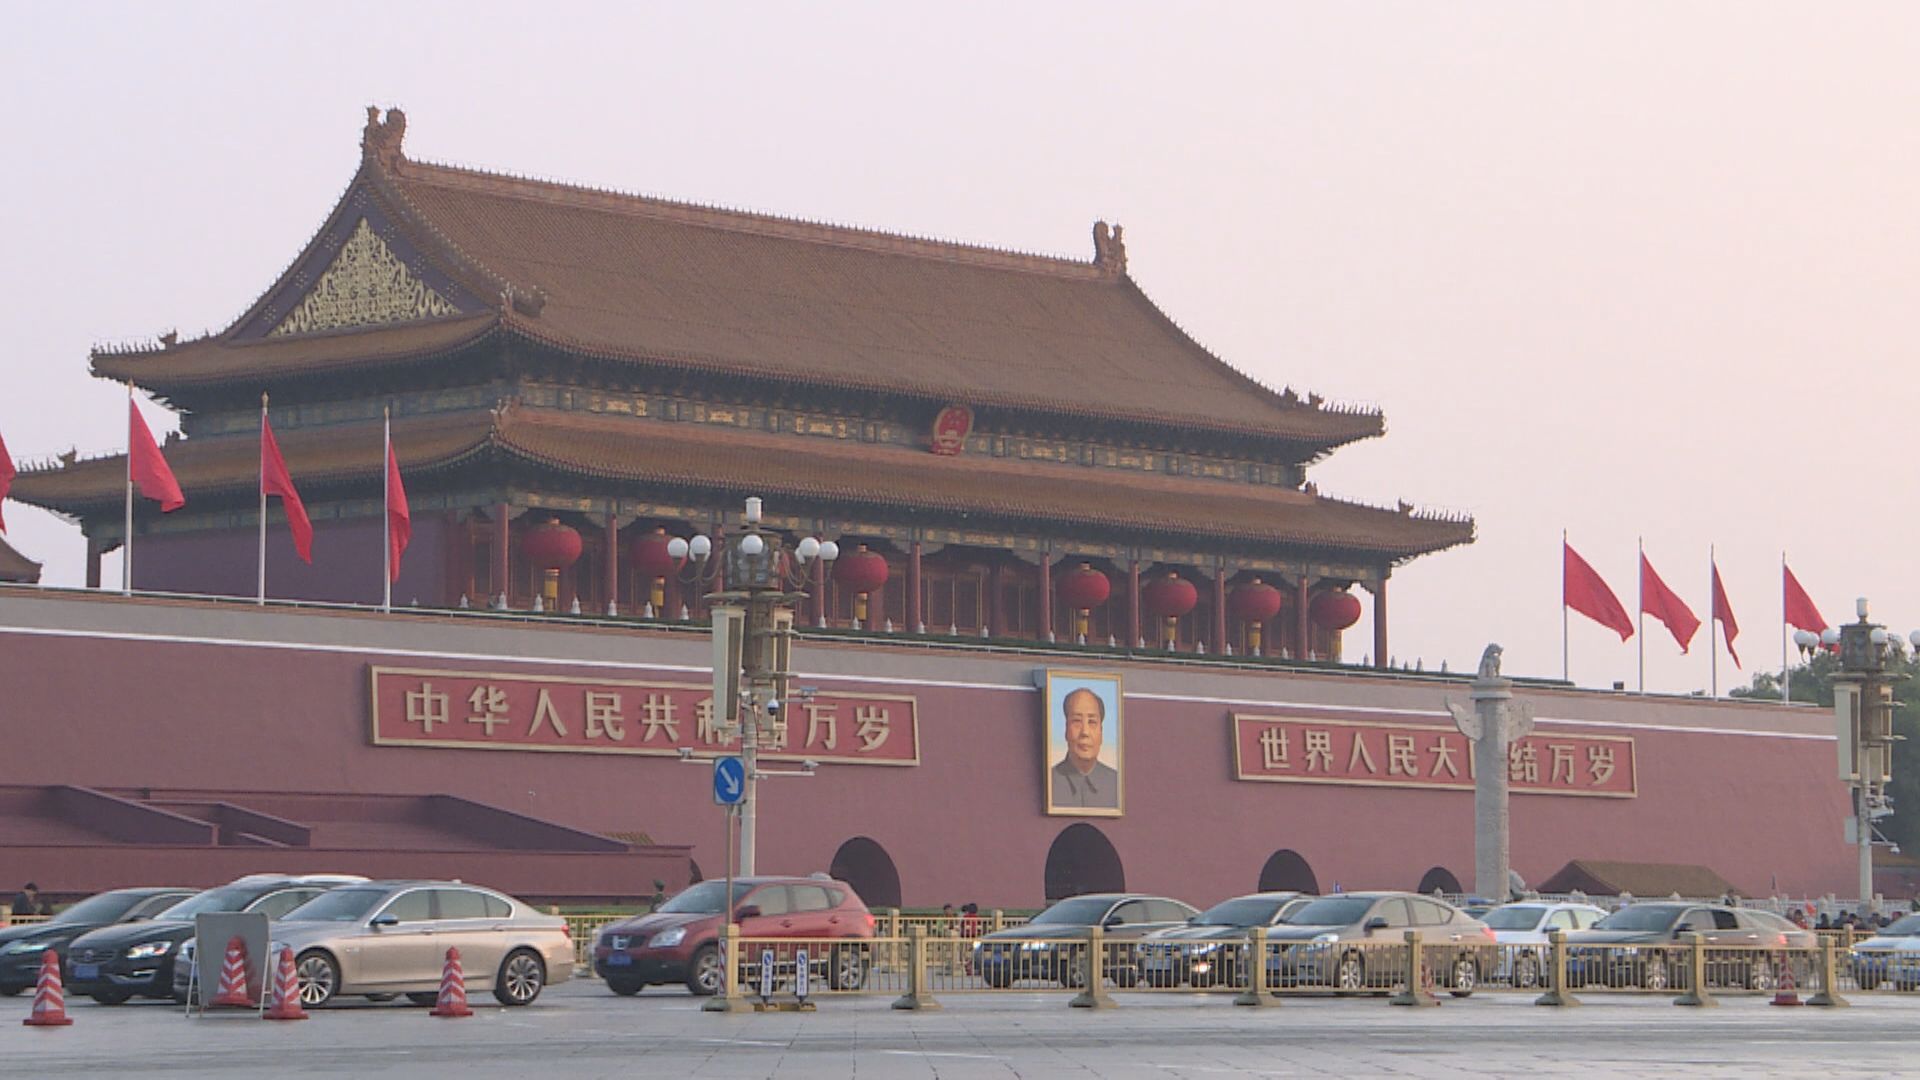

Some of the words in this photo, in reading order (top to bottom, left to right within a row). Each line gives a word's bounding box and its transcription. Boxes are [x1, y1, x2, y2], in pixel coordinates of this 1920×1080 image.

[405, 682, 891, 752] 中华人民共万岁
[1260, 727, 1615, 785] 世界人民大结万岁
